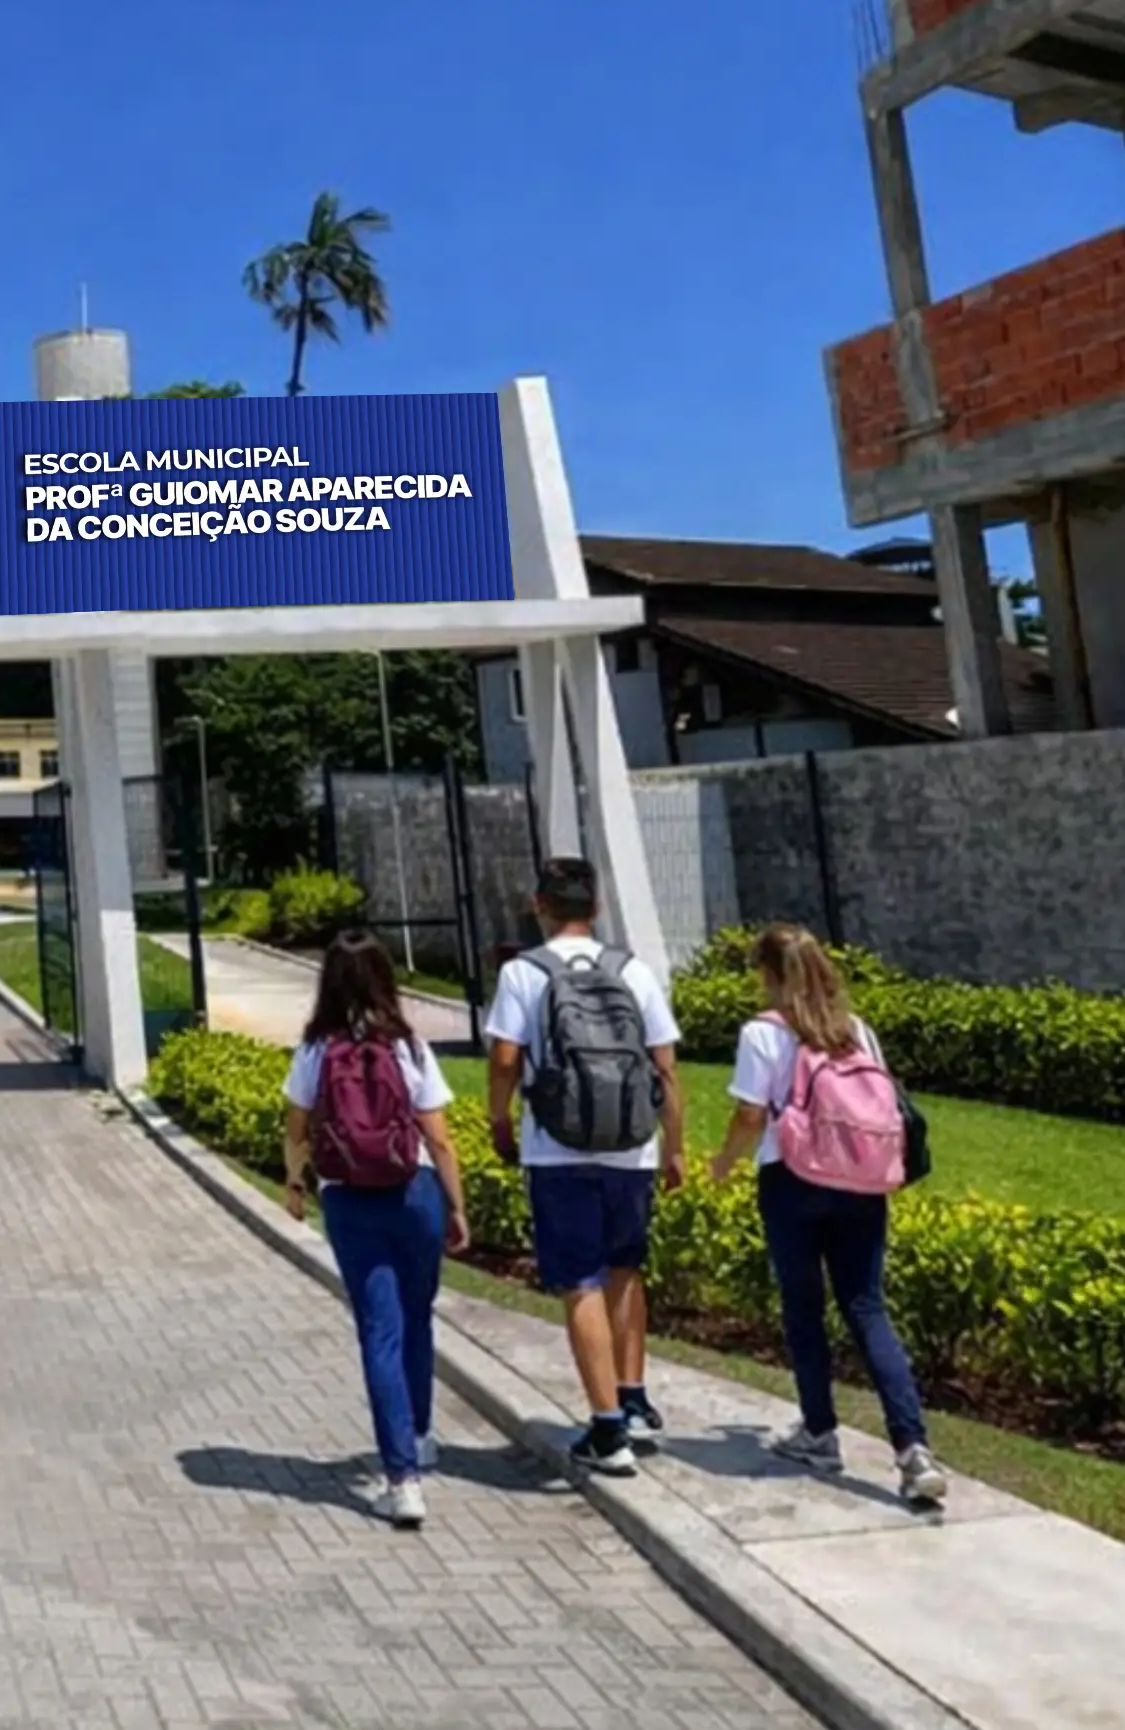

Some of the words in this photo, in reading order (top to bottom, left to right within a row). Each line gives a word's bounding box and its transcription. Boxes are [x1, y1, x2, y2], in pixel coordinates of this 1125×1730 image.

[24, 452, 140, 475] ESCOLA
[146, 447, 310, 471] MUNICIPAL
[129, 479, 283, 507] GUIOMAR
[287, 474, 472, 502] APARECIDA
[27, 517, 73, 542] DA
[78, 504, 272, 543] CONCEIÇÃO
[275, 507, 390, 532] SOUZA
